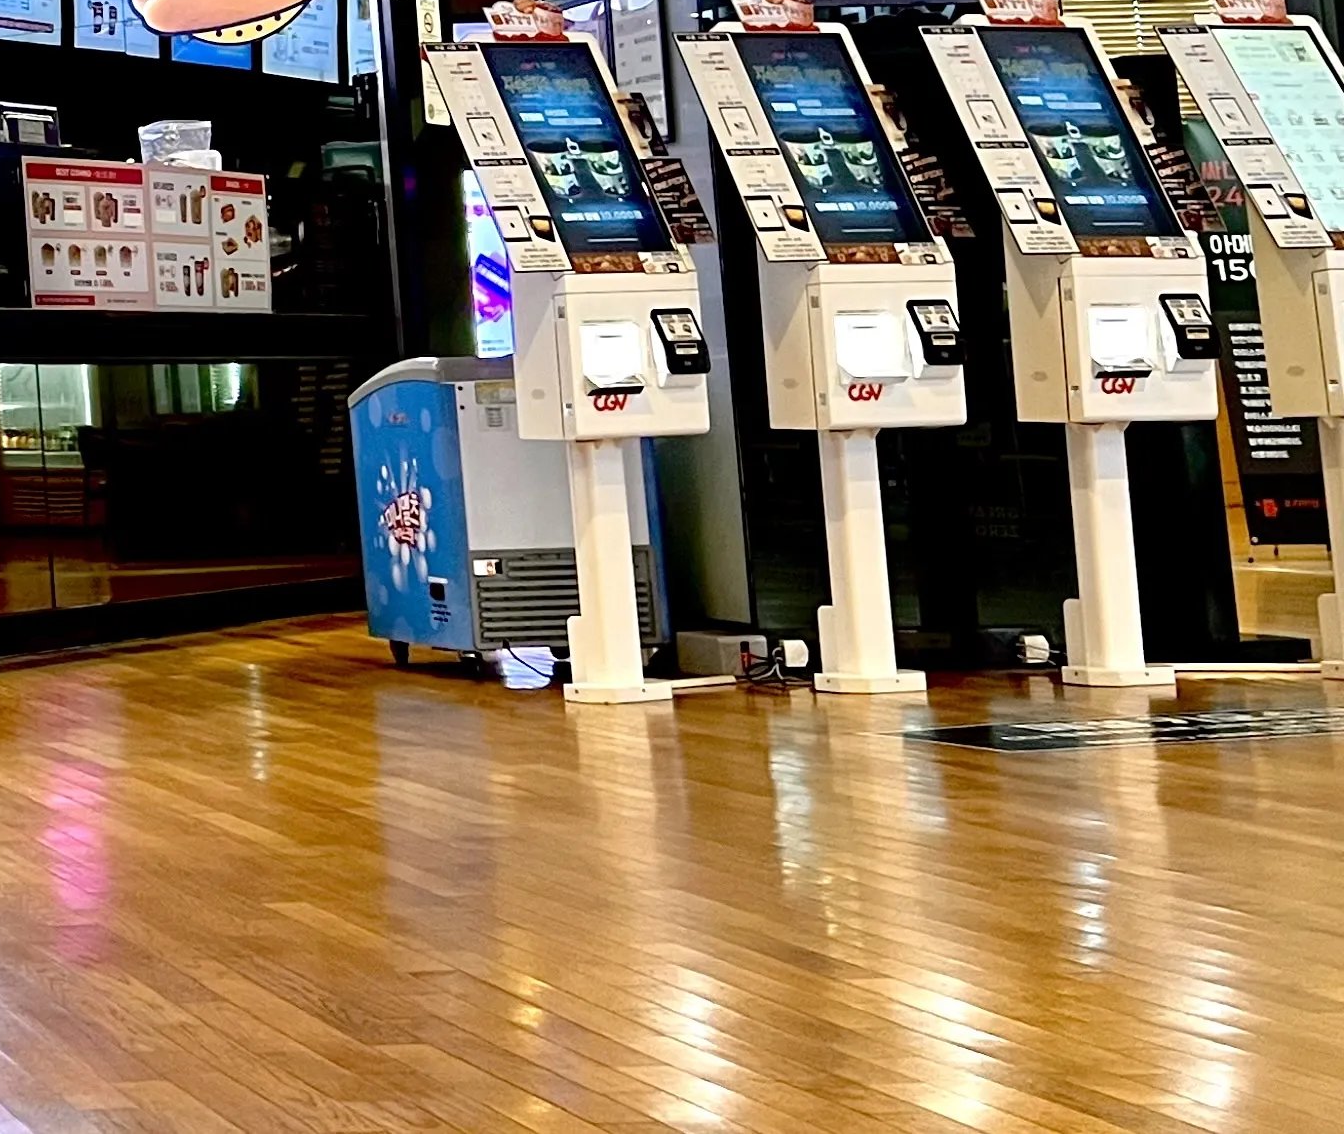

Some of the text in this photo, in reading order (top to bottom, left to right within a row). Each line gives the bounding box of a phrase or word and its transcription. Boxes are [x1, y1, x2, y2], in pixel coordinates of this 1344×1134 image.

[847, 383, 883, 402] CGV
[1100, 377, 1136, 395] CGV
[592, 393, 629, 412] CGV
